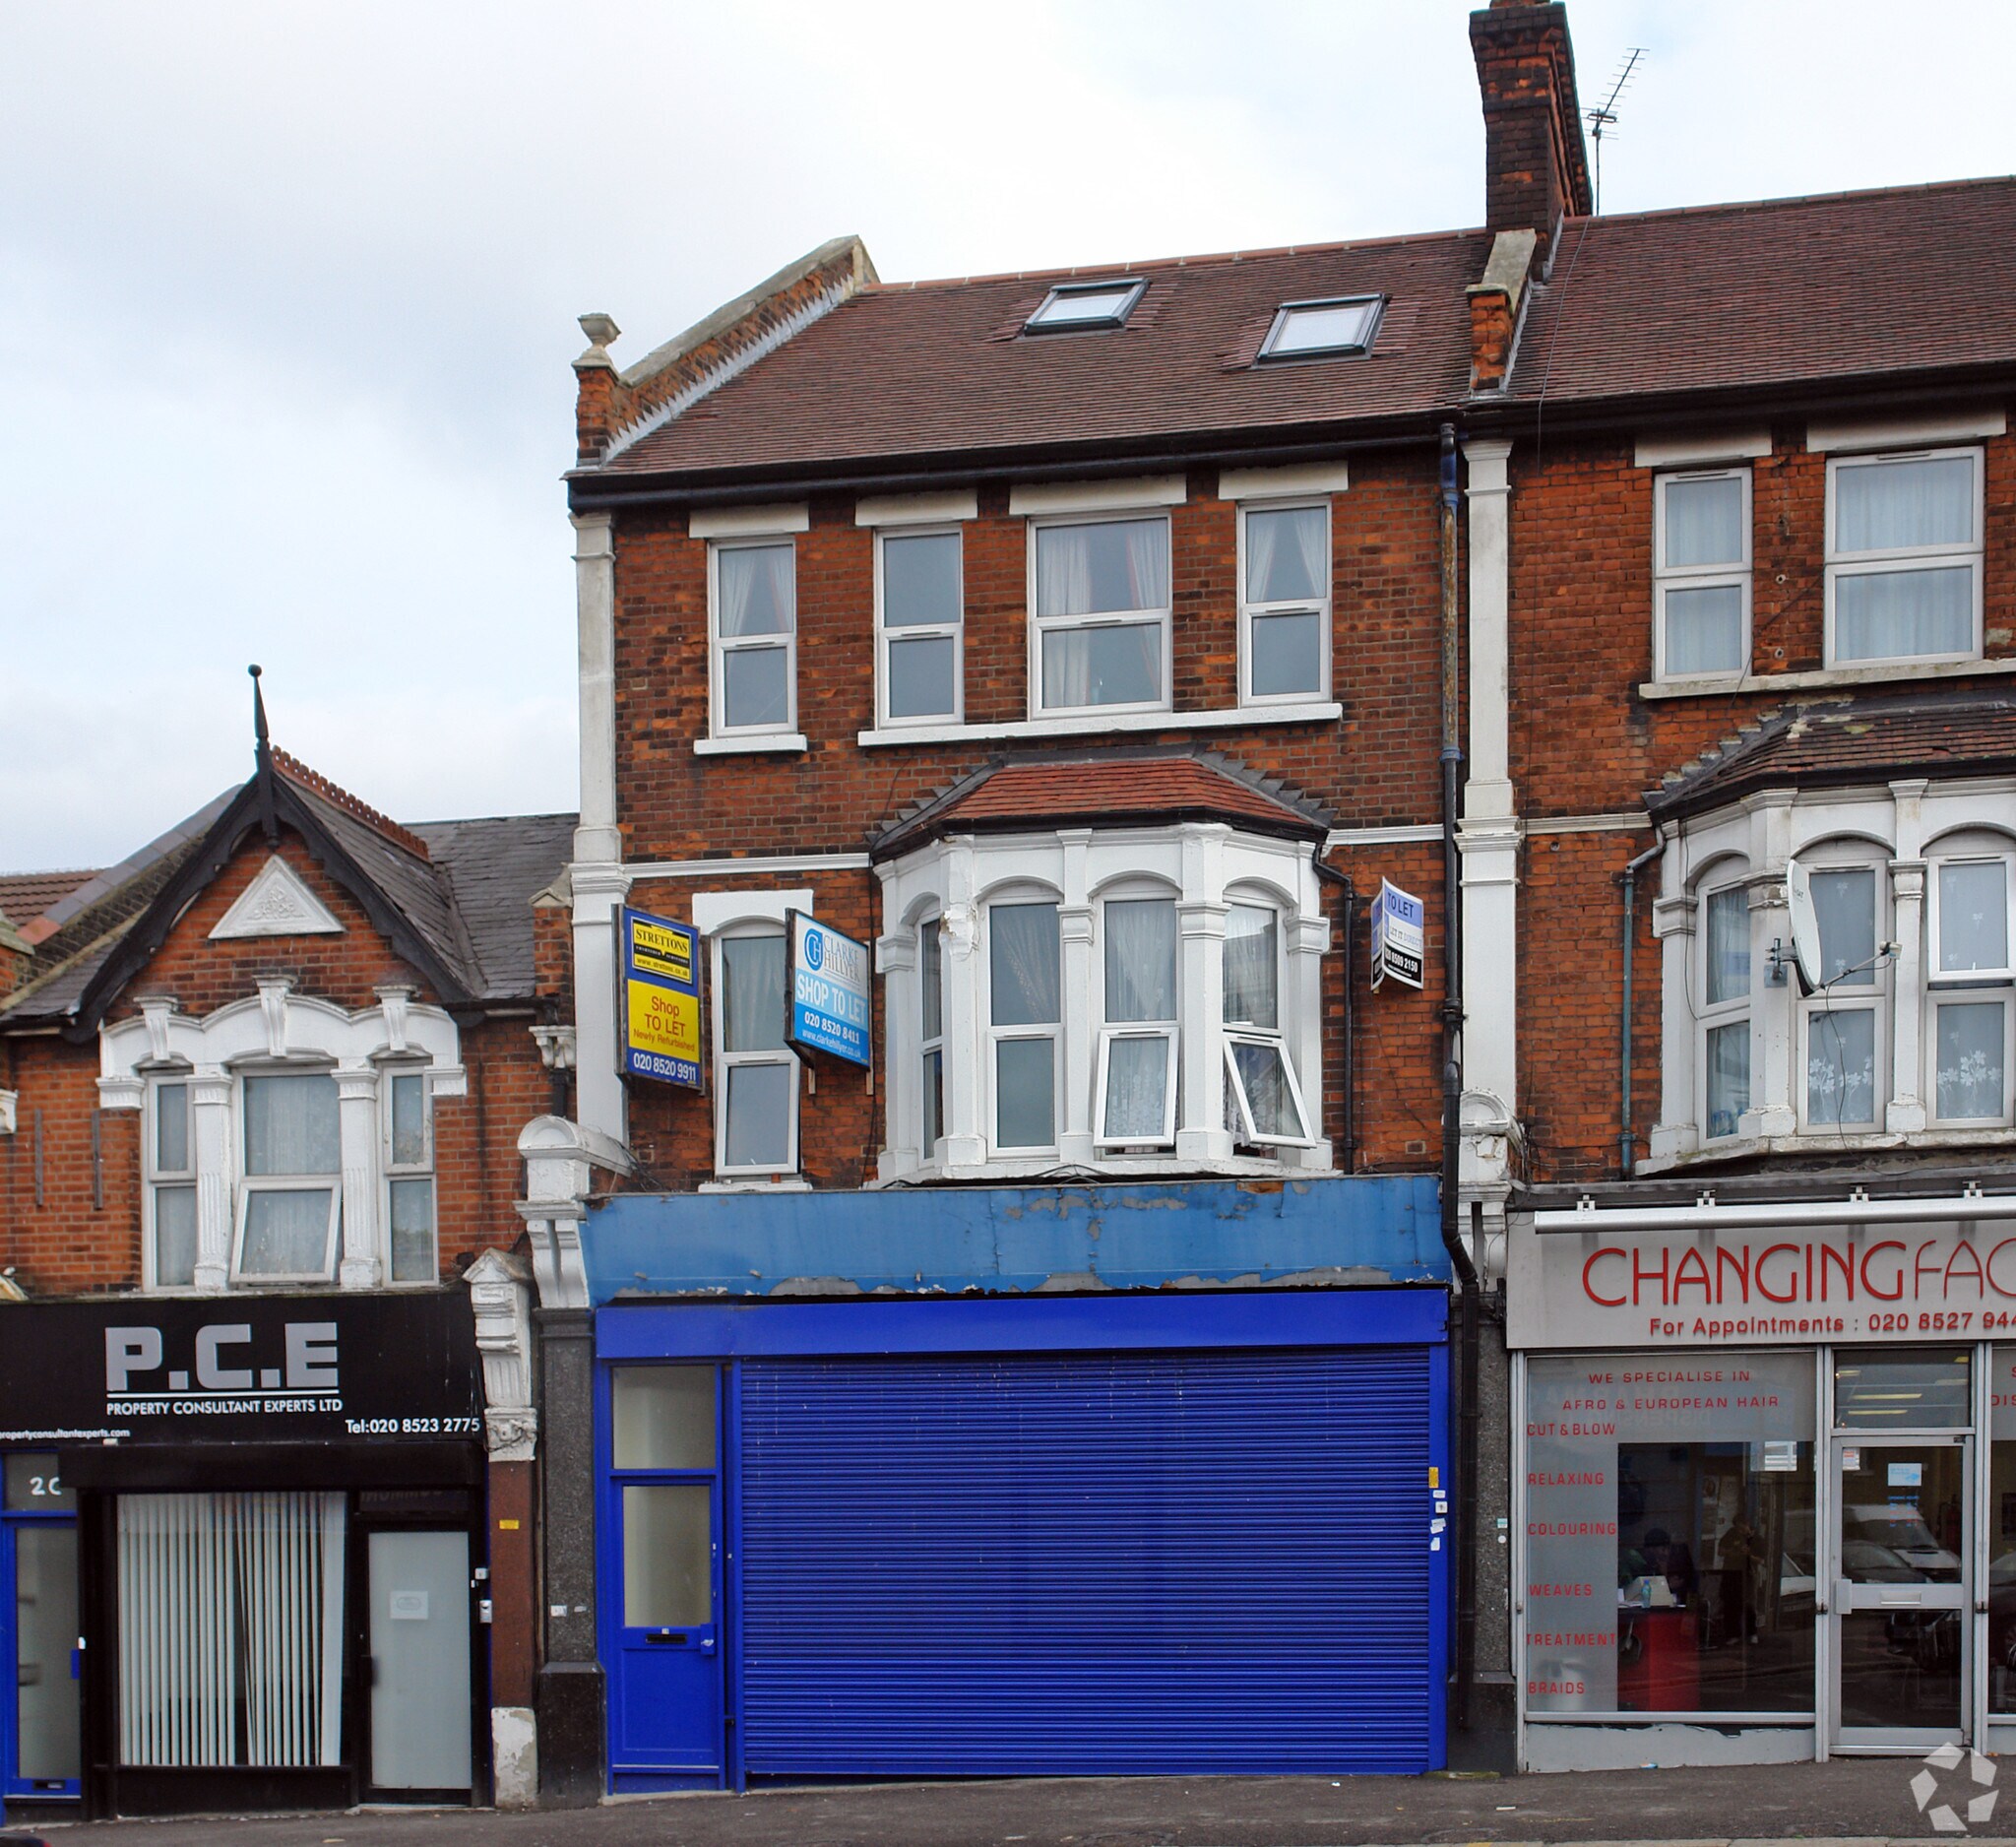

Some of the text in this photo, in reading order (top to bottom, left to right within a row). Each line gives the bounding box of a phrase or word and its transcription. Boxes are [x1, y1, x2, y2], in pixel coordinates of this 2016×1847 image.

[1387, 892, 1414, 918] TO LET
[635, 928, 688, 953] STRETTONS
[824, 934, 858, 965] CLARKE
[824, 951, 860, 983] HILLYER
[651, 995, 680, 1019] Shop
[797, 973, 829, 1008] SHOP
[832, 987, 846, 1016] TO
[848, 993, 866, 1026] LET
[644, 1013, 686, 1038] TO LET
[804, 1011, 860, 1046] 020 8520 8411
[633, 1028, 695, 1052] Newly Refurbished
[633, 1051, 697, 1082] 020 8520 9911
[1650, 1318, 1683, 1336] For
[1693, 1312, 1844, 1339] Appointments
[1868, 1313, 1909, 1330] 020
[1919, 1311, 1973, 1330] 8527
[105, 1322, 339, 1392] P.C.E
[1589, 1370, 1750, 1384] WE SPECIALISE IN
[106, 1398, 343, 1416] PROPERTY CONSULTANT EXPERTS LTD
[1562, 1396, 1779, 1411] AFRO & EUROPEAN HAIR
[346, 1417, 480, 1433] Tel:020 8523 2775
[1527, 1424, 1555, 1436] CUT
[1572, 1423, 1615, 1435] BLOW
[1528, 1473, 1605, 1486] RELAXING
[1528, 1522, 1616, 1536] COLOURING
[1529, 1583, 1593, 1597] WEAVES
[1526, 1632, 1616, 1646] TREATMENT
[1528, 1682, 1586, 1694] BRAIDS
